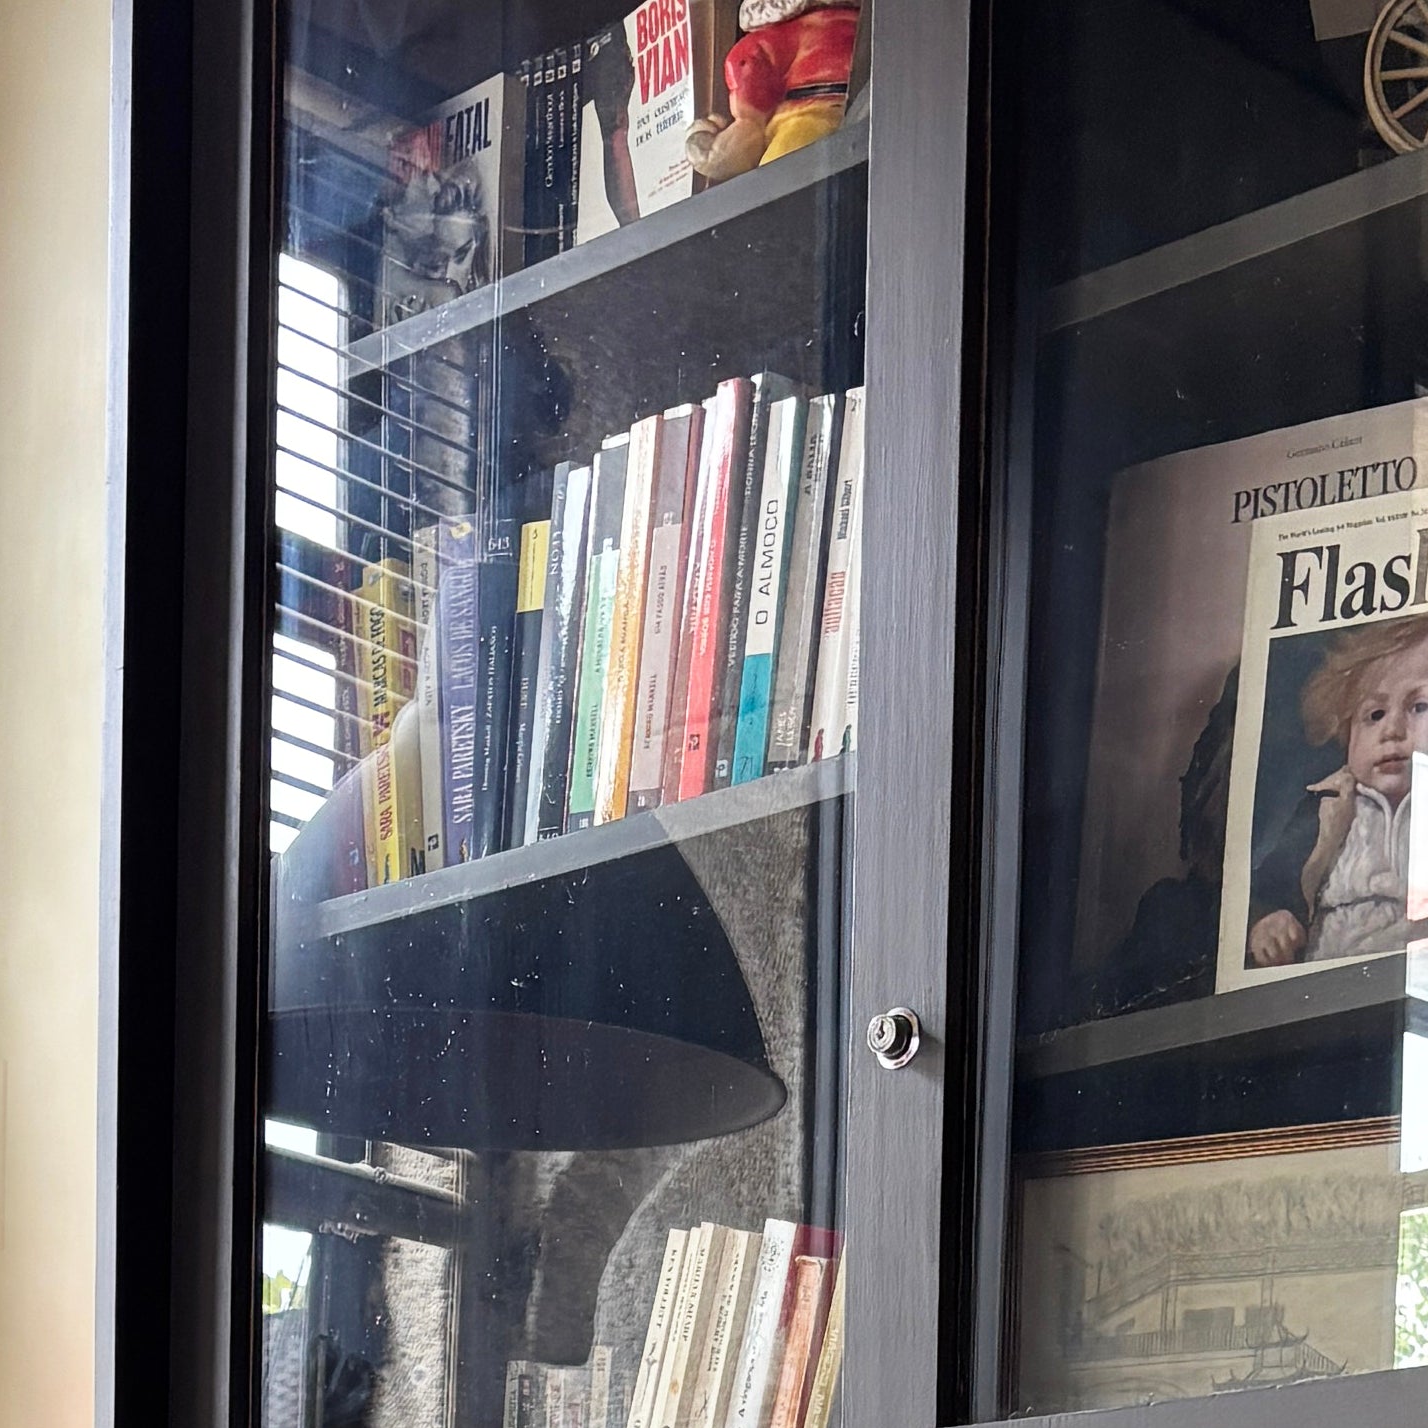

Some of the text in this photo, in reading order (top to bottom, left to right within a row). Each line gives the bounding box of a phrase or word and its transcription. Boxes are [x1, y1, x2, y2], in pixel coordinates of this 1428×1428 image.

[637, 0, 686, 54] BORIS
[638, 22, 689, 105] VIAN
[445, 97, 491, 166] FATAL
[1231, 456, 1418, 524] PISTOLETTO
[449, 619, 474, 641] DE
[753, 608, 769, 626] O
[450, 704, 474, 824] SARA PARETSKY
[377, 806, 393, 841] SARA
